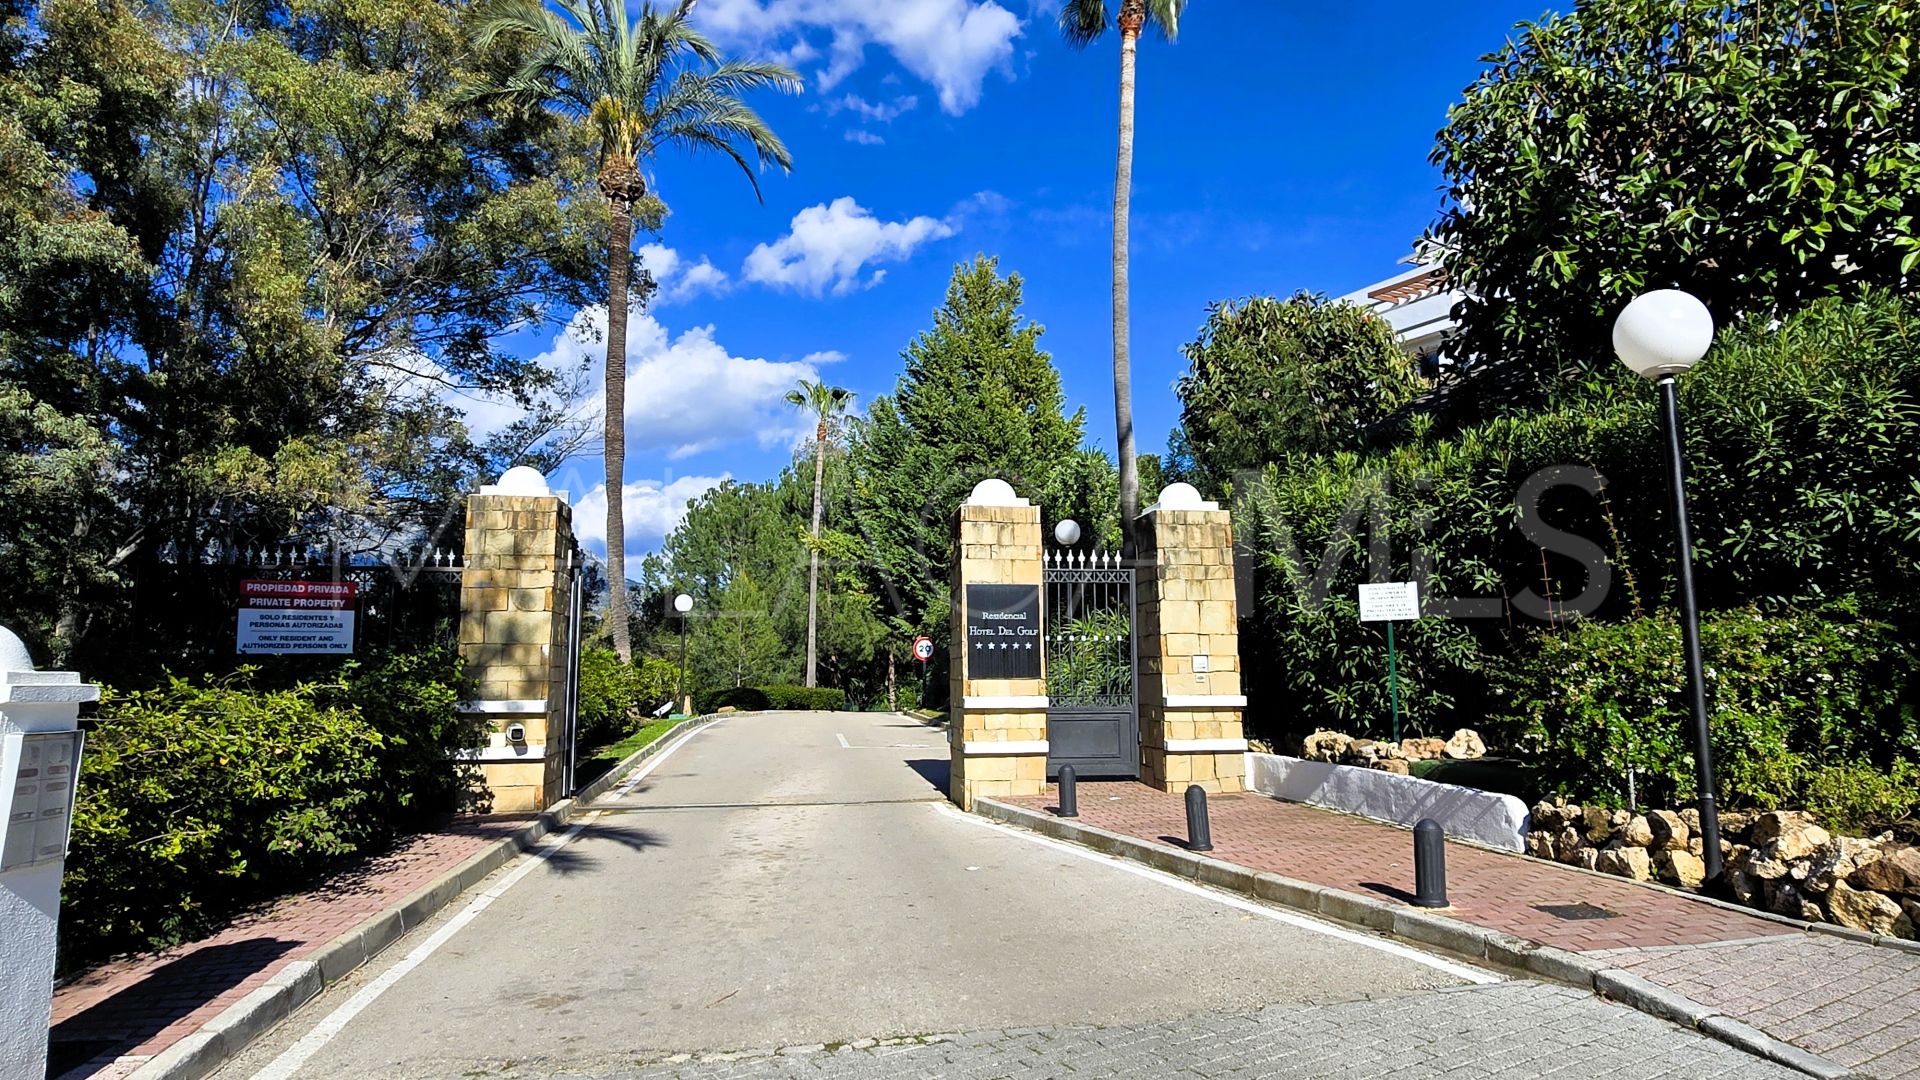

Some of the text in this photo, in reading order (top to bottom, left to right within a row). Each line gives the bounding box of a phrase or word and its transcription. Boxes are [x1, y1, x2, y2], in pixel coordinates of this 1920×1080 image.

[246, 583, 349, 594] PROPIEDAD PRIVADA
[249, 597, 346, 608] PRIVATE PROPERTY
[982, 611, 1027, 620] Residencial
